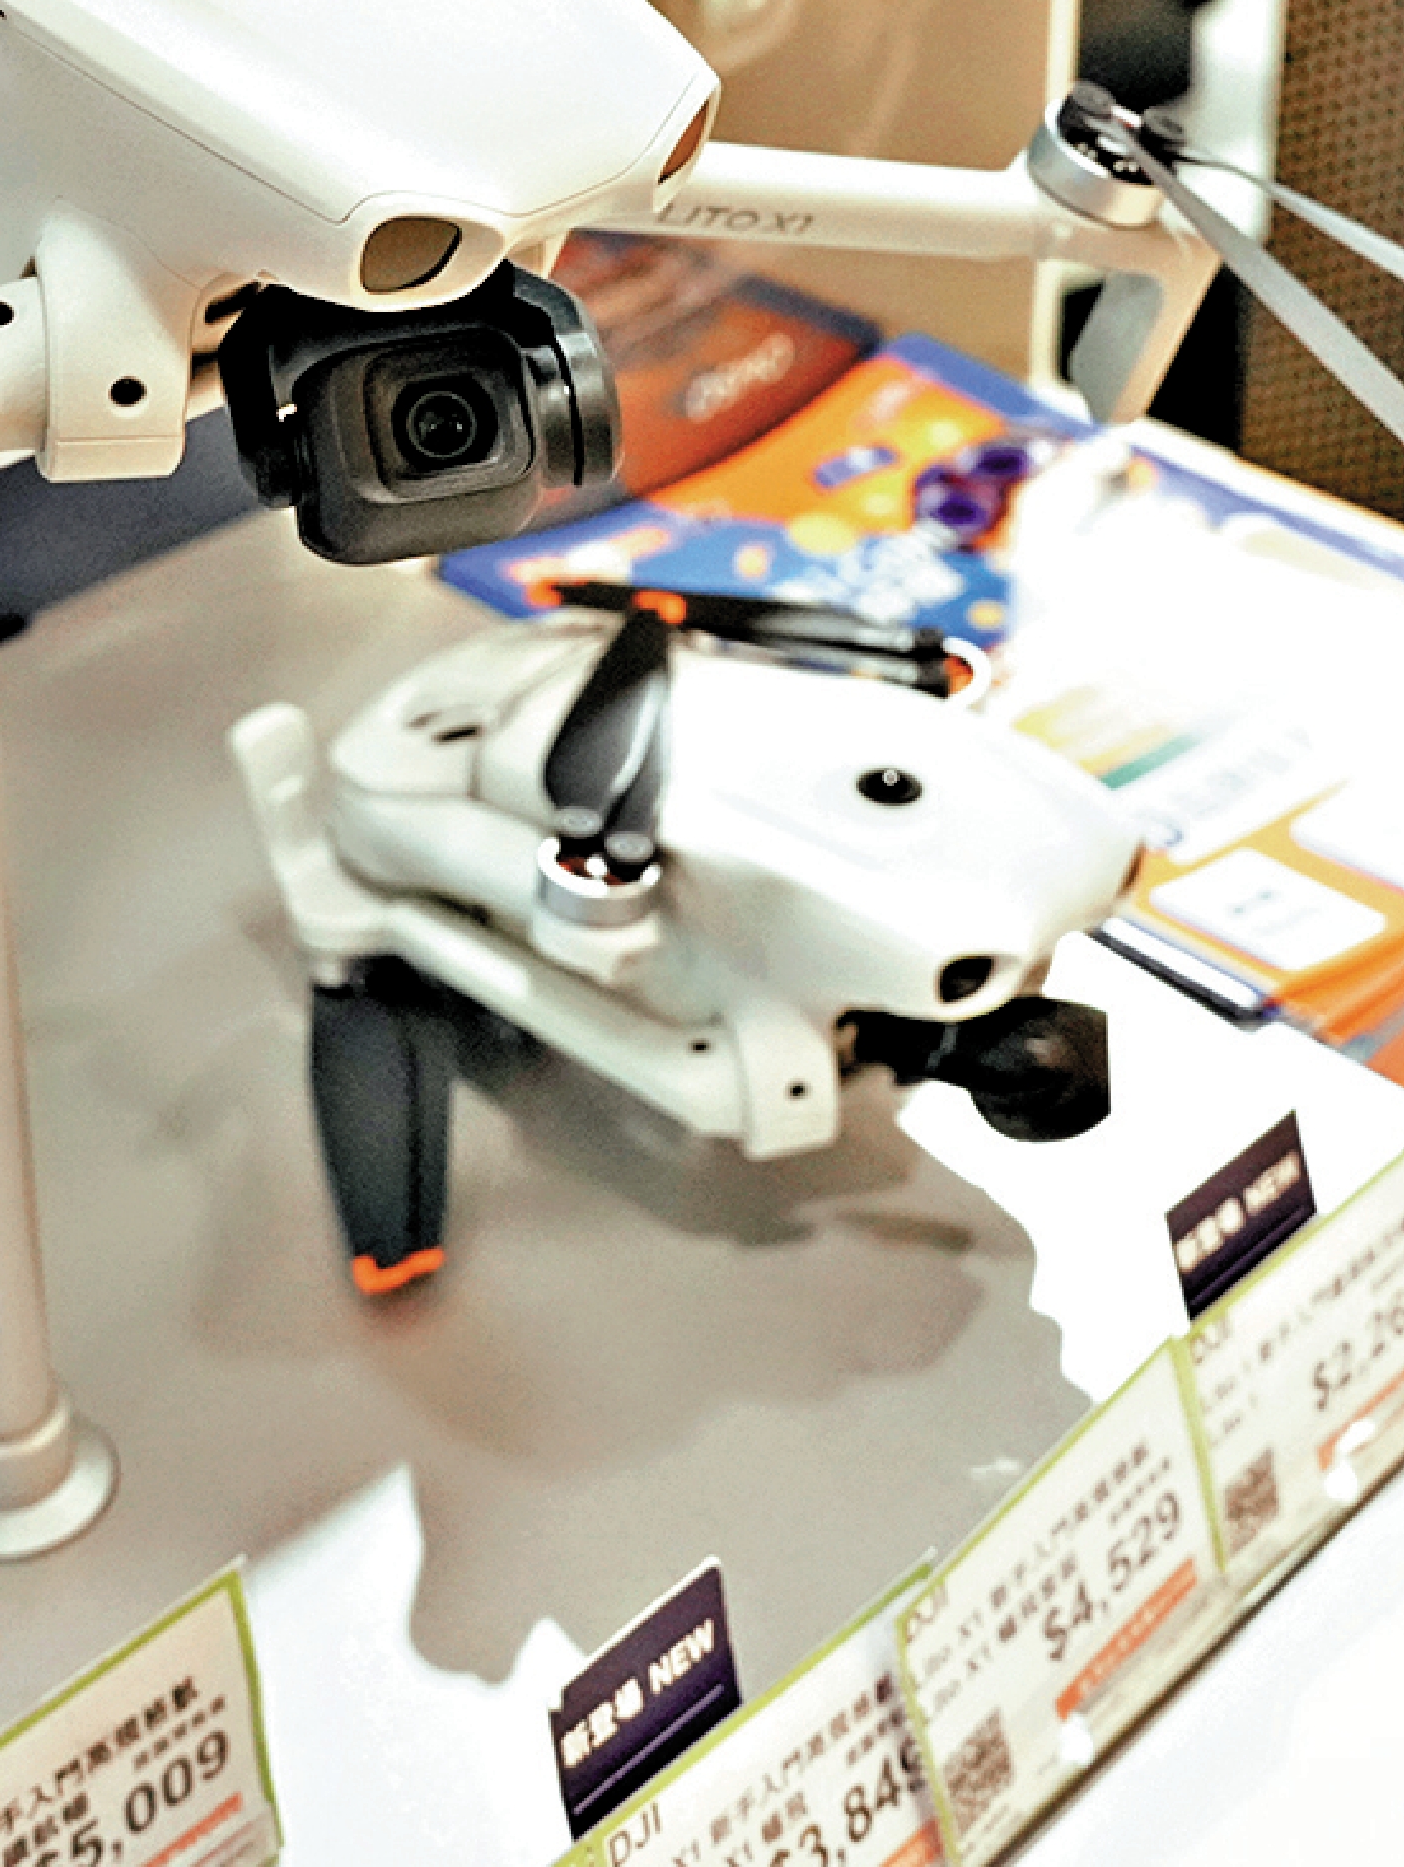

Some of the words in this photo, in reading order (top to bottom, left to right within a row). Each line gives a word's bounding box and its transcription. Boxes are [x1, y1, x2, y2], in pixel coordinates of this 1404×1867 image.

[655, 201, 760, 231] LITO
[1043, 1489, 1181, 1662] $4,529
[646, 1617, 717, 1695] NEW
[608, 1801, 663, 1867] DJI
